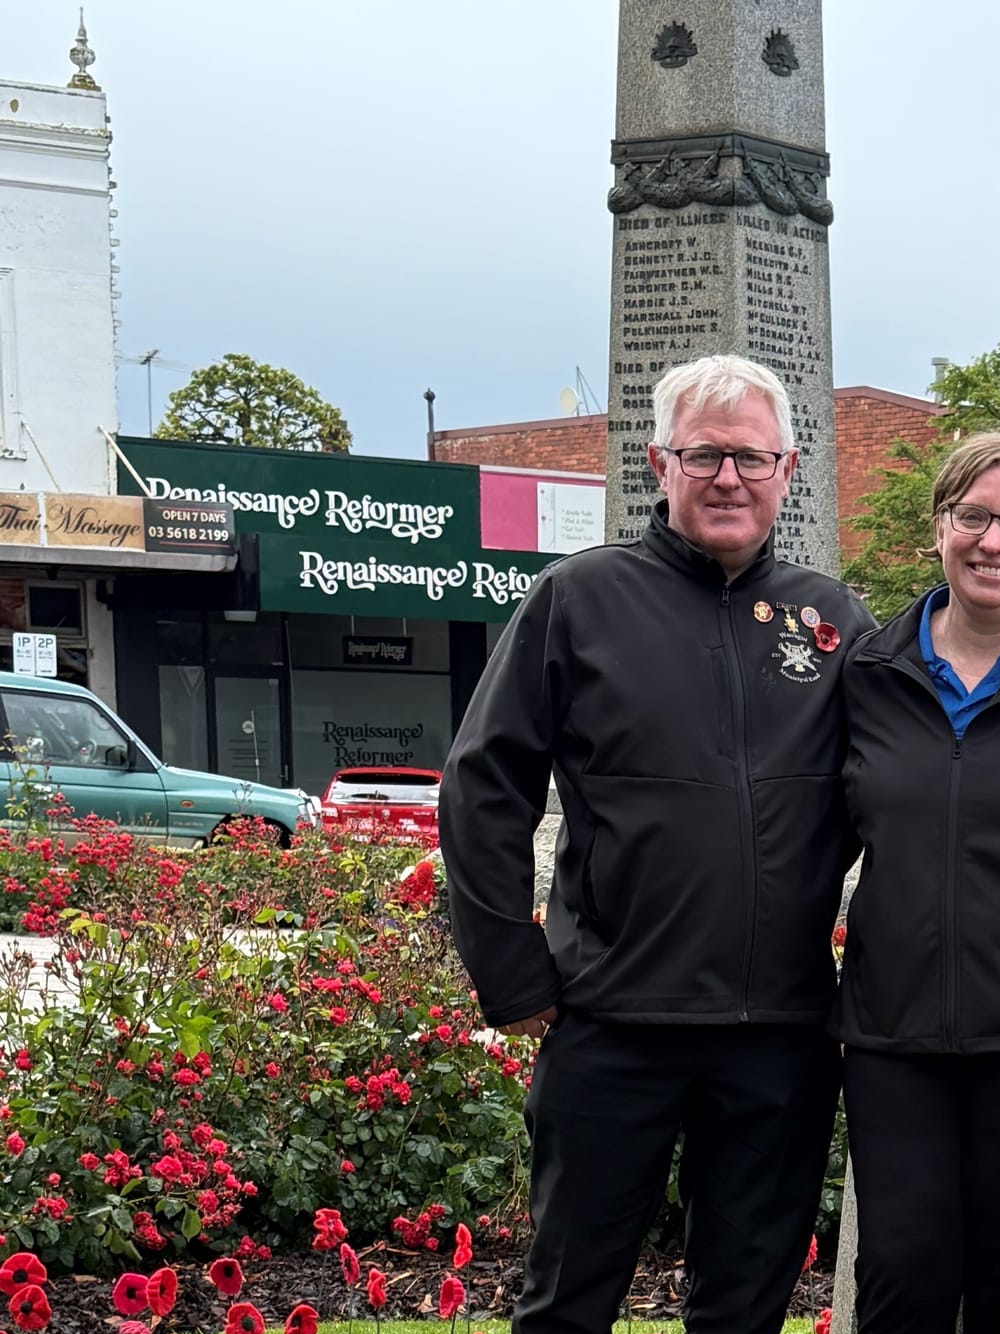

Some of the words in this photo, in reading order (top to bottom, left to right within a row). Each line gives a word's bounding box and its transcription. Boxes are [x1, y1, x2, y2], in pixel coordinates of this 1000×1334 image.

[623, 311, 682, 323] MARSHALL
[46, 503, 142, 547] Massage
[162, 510, 191, 522] OPEN
[192, 511, 199, 522] 7
[201, 512, 227, 523] DAYS
[324, 490, 454, 544] Reformer
[148, 526, 164, 538] 03
[167, 527, 197, 540] 5618
[199, 528, 229, 542] 2199
[299, 551, 468, 601] Renaissance
[17, 637, 31, 648] 1P
[38, 637, 54, 648] 2P
[322, 721, 424, 747] Renaissance
[334, 747, 414, 768] Reformer
